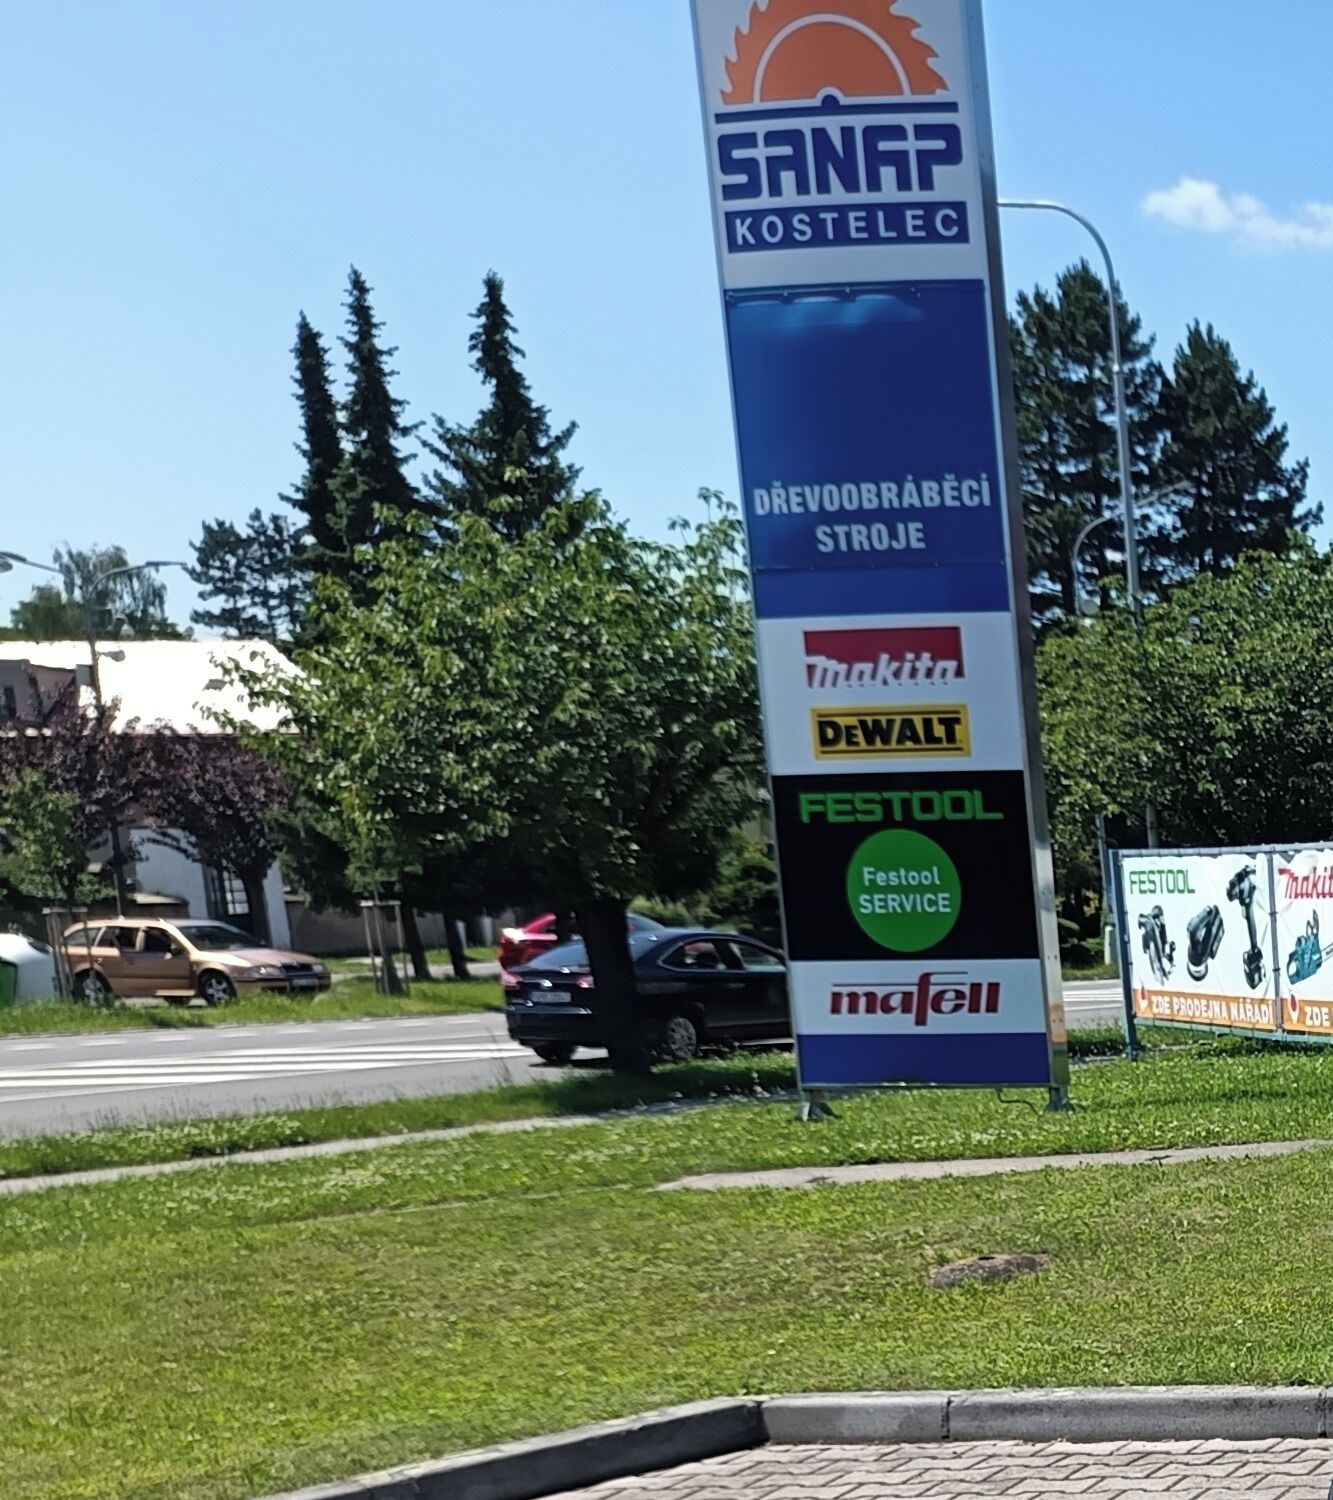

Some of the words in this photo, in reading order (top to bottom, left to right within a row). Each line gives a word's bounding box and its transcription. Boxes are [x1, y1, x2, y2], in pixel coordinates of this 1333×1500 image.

[717, 123, 963, 201] SANAP
[735, 208, 960, 245] KOSTELEC
[753, 471, 992, 517] DŘEVOOBRÁBĚCÍ
[815, 522, 926, 553] STROJE
[799, 789, 1004, 824] FESTOOL
[863, 865, 941, 887] Festool
[1129, 869, 1195, 895] FESTOOL
[859, 893, 951, 915] SERVICE
[830, 971, 1001, 1027] mafell
[1151, 995, 1171, 1015] ZDE
[1173, 996, 1229, 1021] PRODEJNA
[1230, 998, 1274, 1025] NÁŘADÍ
[1304, 1006, 1331, 1027] ZDE
